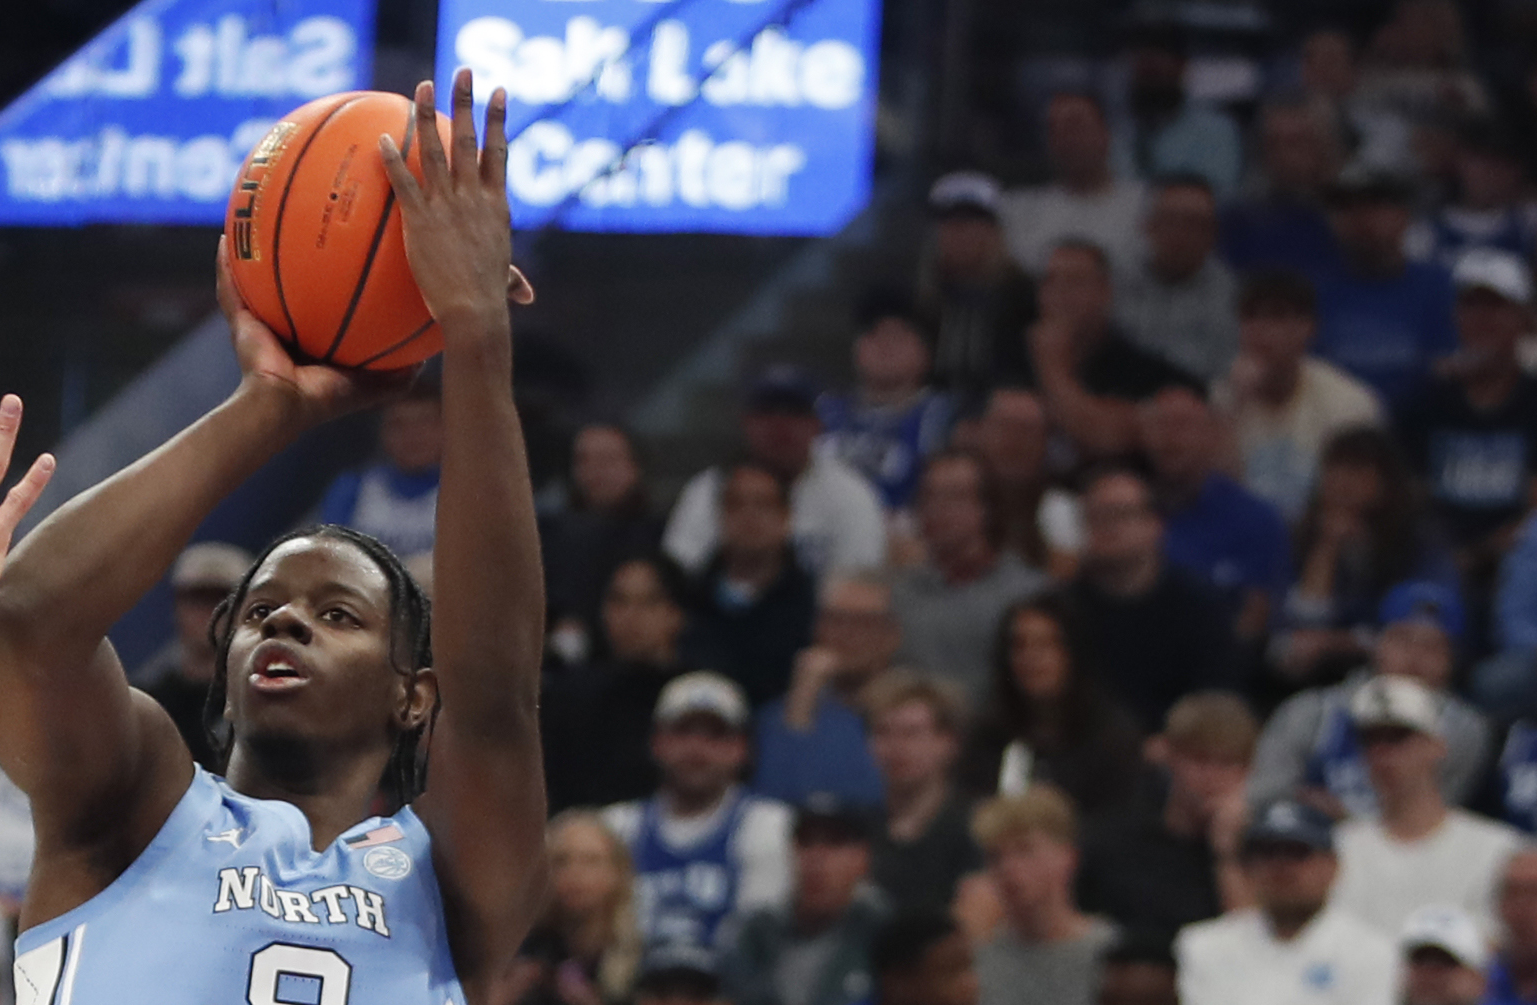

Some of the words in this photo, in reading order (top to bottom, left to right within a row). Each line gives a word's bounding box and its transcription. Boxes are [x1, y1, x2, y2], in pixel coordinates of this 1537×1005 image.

[455, 15, 630, 102] Salt
[648, 18, 864, 110] Lake
[507, 120, 807, 212] Center
[214, 866, 391, 938] NORTH
